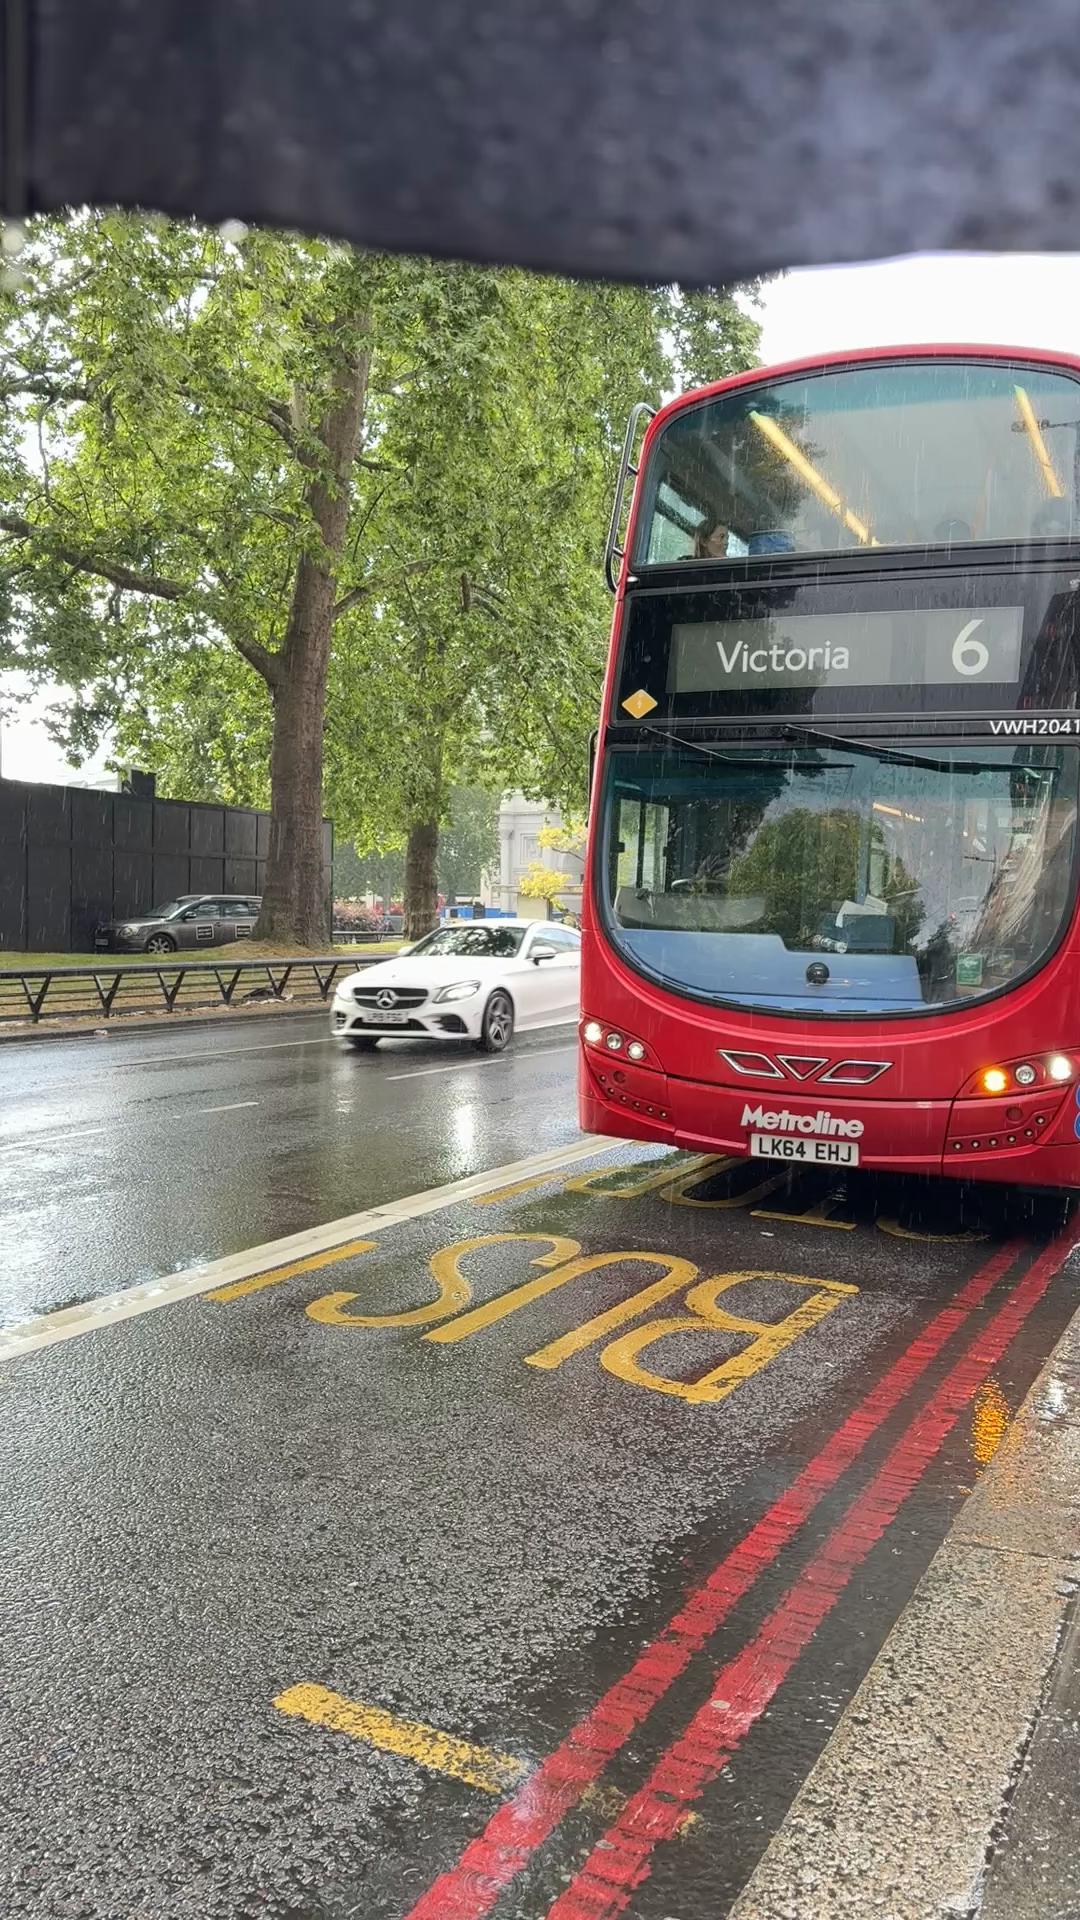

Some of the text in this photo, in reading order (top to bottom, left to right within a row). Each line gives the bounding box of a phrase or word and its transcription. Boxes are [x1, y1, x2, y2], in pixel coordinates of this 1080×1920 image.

[715, 618, 990, 676] Victoria 6
[989, 719, 1080, 735] VWH2041
[740, 1103, 864, 1138] Metroline
[758, 1137, 852, 1163] LK64 EHJ
[305, 1232, 861, 1404] BUS
